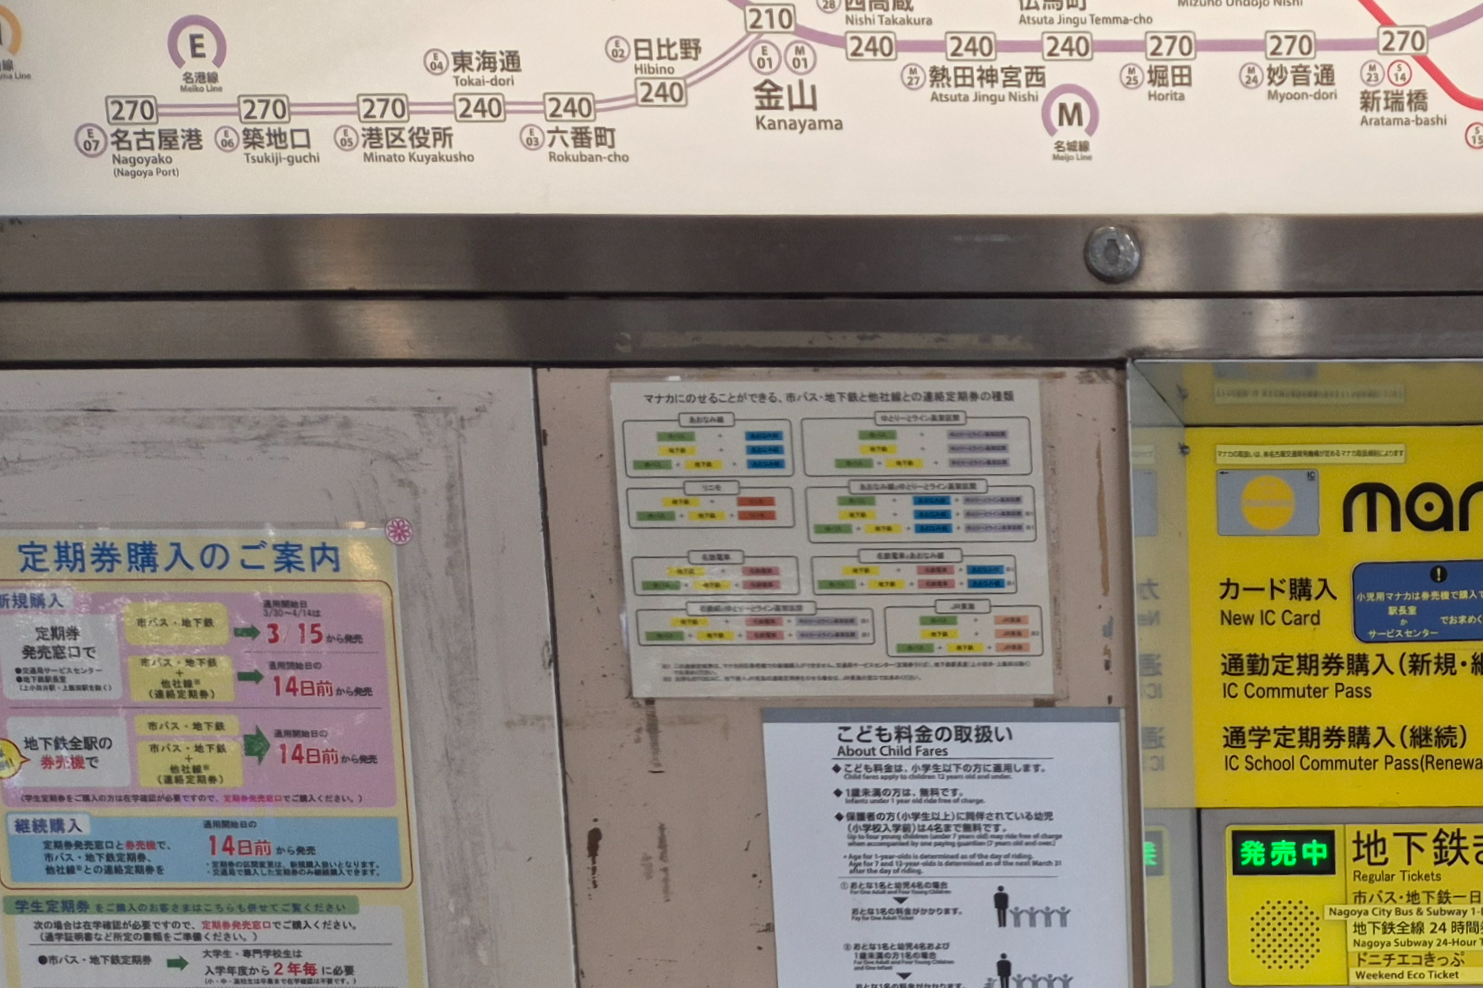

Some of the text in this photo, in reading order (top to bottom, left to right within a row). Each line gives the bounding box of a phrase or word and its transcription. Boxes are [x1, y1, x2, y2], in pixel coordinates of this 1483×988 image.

[747, 7, 794, 31] 210
[850, 36, 893, 57] 240
[1382, 30, 1425, 51] 270
[634, 38, 701, 61] 日比野
[451, 50, 522, 73] 東海通
[634, 63, 675, 74] Hibino
[453, 75, 514, 86] Tokai-dori
[929, 65, 1045, 88] 熱田神宮西
[753, 79, 817, 111] 金山
[931, 91, 1038, 105] Atsuta Jingu Nishi
[1360, 89, 1427, 112] 新瑞橋
[110, 98, 156, 122] 270
[459, 98, 502, 118] 240
[756, 115, 843, 134] Kanayama
[1360, 115, 1447, 126] Aratama-bashi
[111, 128, 203, 151] 名古屋港
[242, 127, 310, 150] 築地口
[362, 127, 453, 149] 港区役所
[547, 126, 615, 149] 六番町
[112, 154, 172, 167] Nagoyako
[244, 152, 319, 166] Tsukiji-guchi
[364, 151, 474, 165] Minato Kuyakusho
[549, 151, 629, 162] Rokuban-cho
[114, 167, 179, 179] (Nagoya Port)
[18, 541, 340, 573] 定期券購入のご案内
[1220, 578, 1337, 601] カード購入
[1221, 610, 1320, 626] New IC Card
[35, 626, 80, 641] 定期券
[22, 645, 95, 659] 発売窓口で
[1223, 683, 1372, 698] IC Commuter Pass
[838, 725, 1012, 743] こども料金の取扱い
[1223, 725, 1466, 749] 通学定期券購入（継続）
[24, 736, 112, 751] 地下鉄全駅の
[837, 745, 948, 756] About Child Fares
[41, 755, 98, 769] 券売機で
[280, 744, 338, 764] 14日前
[15, 818, 82, 833] 継続購入
[210, 835, 271, 856] 14日前
[1240, 839, 1328, 866] 発売中
[1354, 870, 1441, 884] Regular Tickets
[15, 899, 90, 913] 学生定期券
[1329, 908, 1369, 918] Nagoya
[1372, 908, 1392, 918] City
[1395, 907, 1413, 916] Bus
[1416, 908, 1423, 916] &
[1427, 907, 1467, 918] Subway
[1353, 921, 1424, 935] 地下鉄全線
[1430, 922, 1447, 933] 24
[1358, 951, 1465, 967] ドニチエコきっぷ
